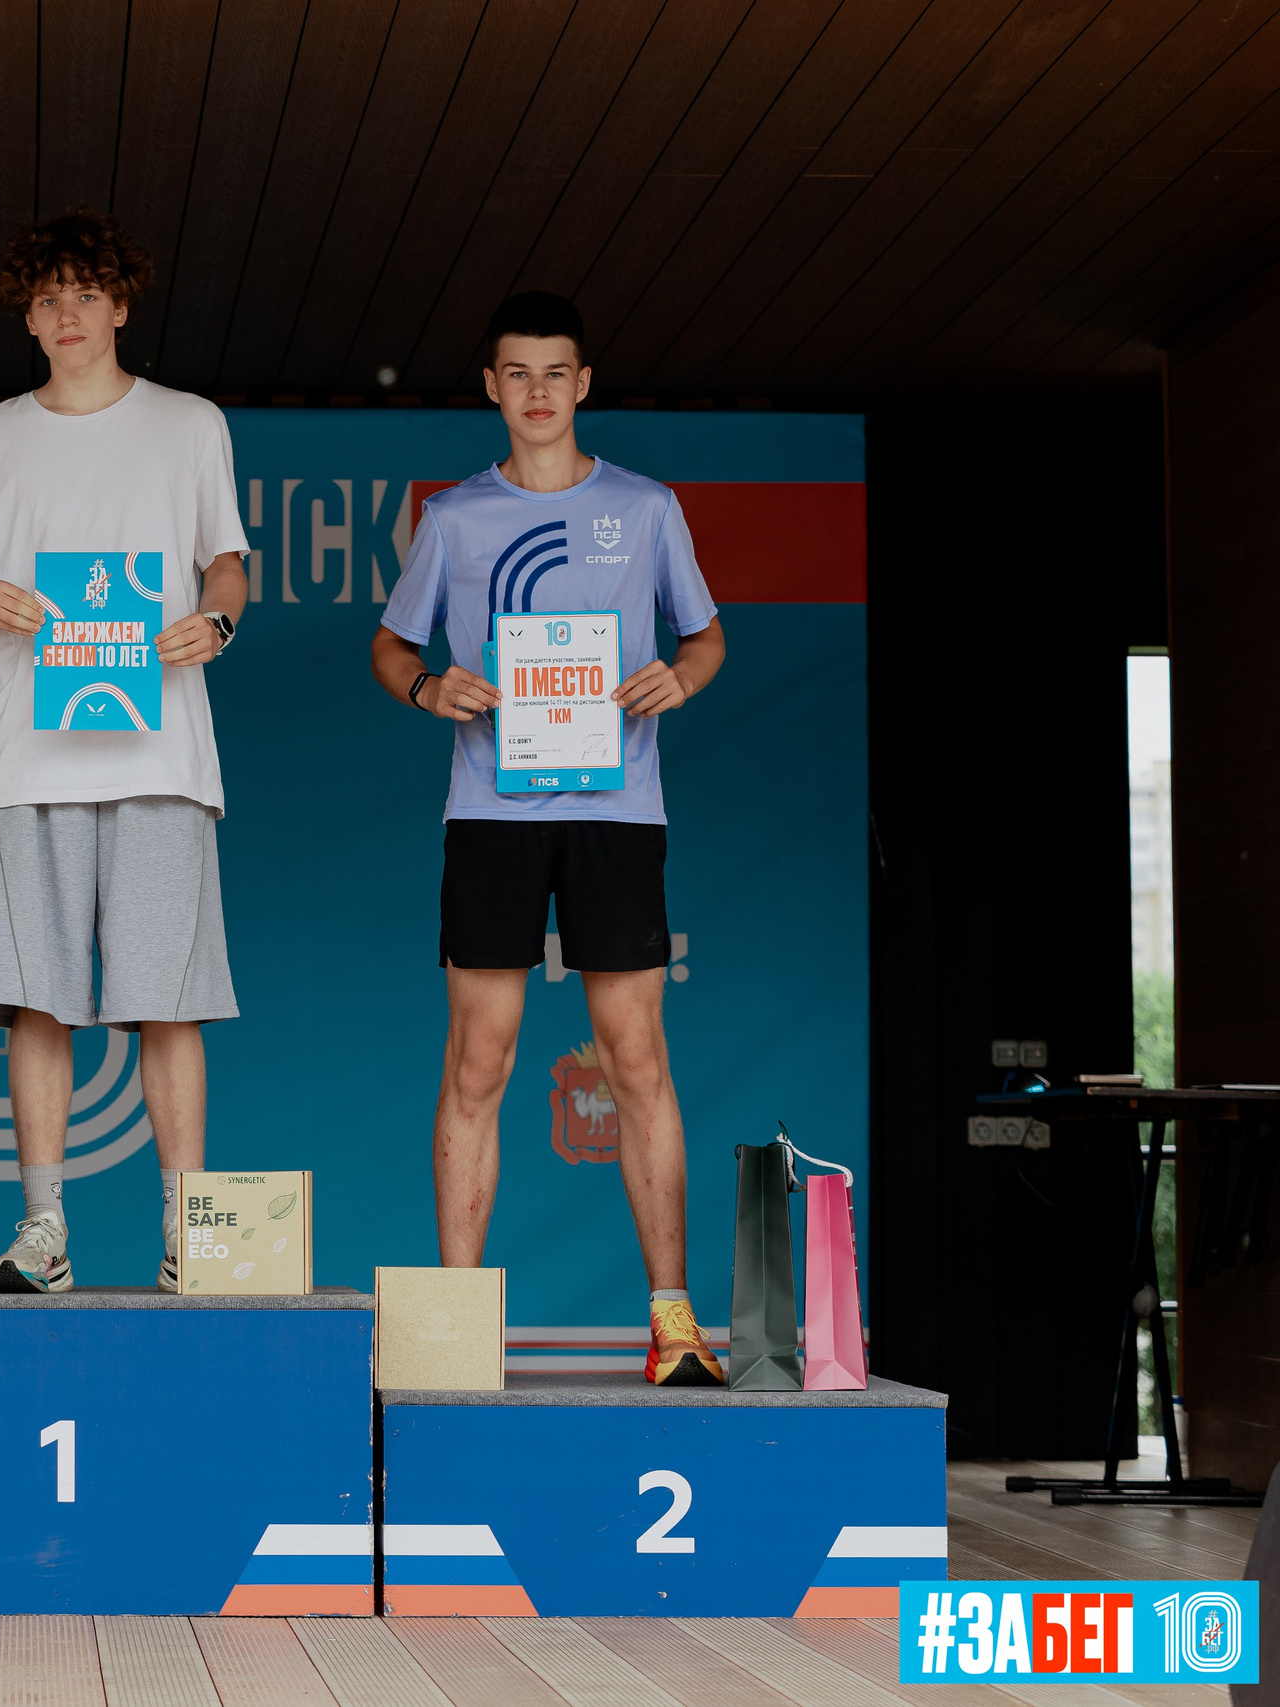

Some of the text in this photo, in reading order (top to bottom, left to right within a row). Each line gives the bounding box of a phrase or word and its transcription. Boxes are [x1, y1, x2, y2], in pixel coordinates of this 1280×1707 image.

[593, 531, 621, 539] ПСБ
[585, 555, 630, 564] СПОРТ
[52, 621, 145, 643] ЗАРЯЖАЕМ
[544, 620, 572, 647] 10
[42, 645, 150, 668] БЕГОМ 10 ЛЕТ
[513, 665, 604, 698] II МЕСТО
[554, 708, 571, 724] КМ
[538, 778, 559, 787] ПСБ
[227, 1176, 266, 1185] SYNERGETIC
[188, 1196, 213, 1210] BE
[187, 1212, 237, 1227] SAFE
[188, 1228, 214, 1243] BE
[188, 1244, 229, 1259] ECO
[39, 1419, 76, 1503] 1
[636, 1470, 694, 1553] 2
